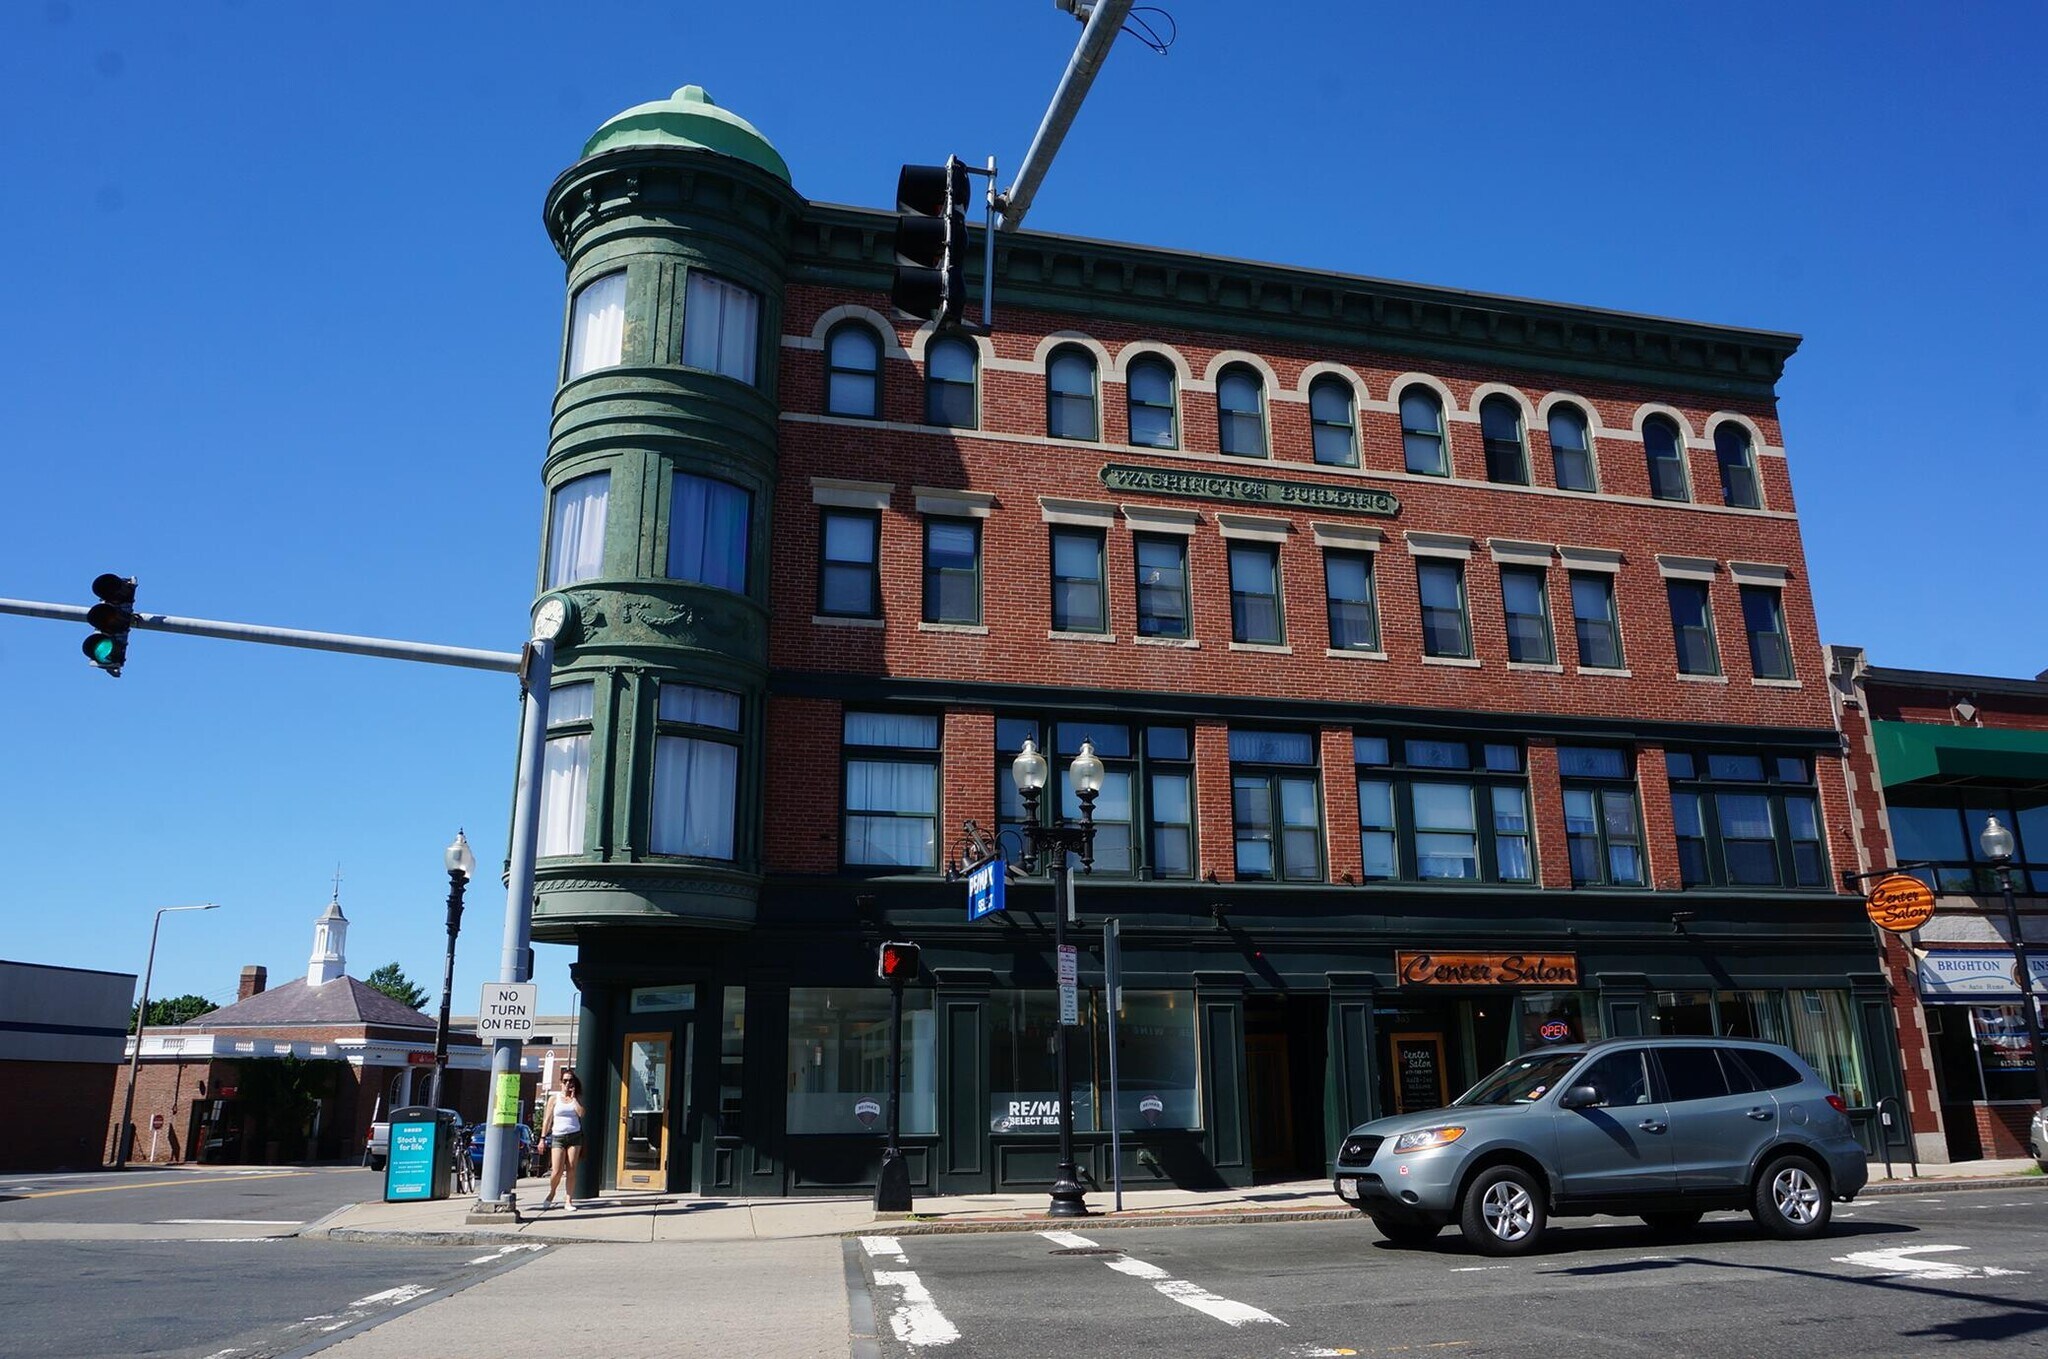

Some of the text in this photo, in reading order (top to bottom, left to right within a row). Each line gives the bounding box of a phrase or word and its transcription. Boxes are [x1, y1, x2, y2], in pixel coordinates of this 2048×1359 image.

[1110, 469, 1389, 510] WASHINGTON BUILDING
[1871, 889, 1919, 906] Center
[1883, 904, 1931, 923] Salon
[1404, 954, 1574, 984] Center Salon
[1937, 960, 2000, 972] BRIGHTON
[498, 991, 519, 1002] NO
[490, 1004, 526, 1016] TURN
[481, 1018, 531, 1030] ON RED
[1540, 1024, 1568, 1037] OPEN
[1403, 1050, 1430, 1060] Center
[1409, 1059, 1432, 1069] Salon
[1009, 1101, 1074, 1116] RE/MA
[1010, 1116, 1042, 1126] SELECT
[396, 1136, 428, 1145] Stock up
[399, 1143, 411, 1151] for
